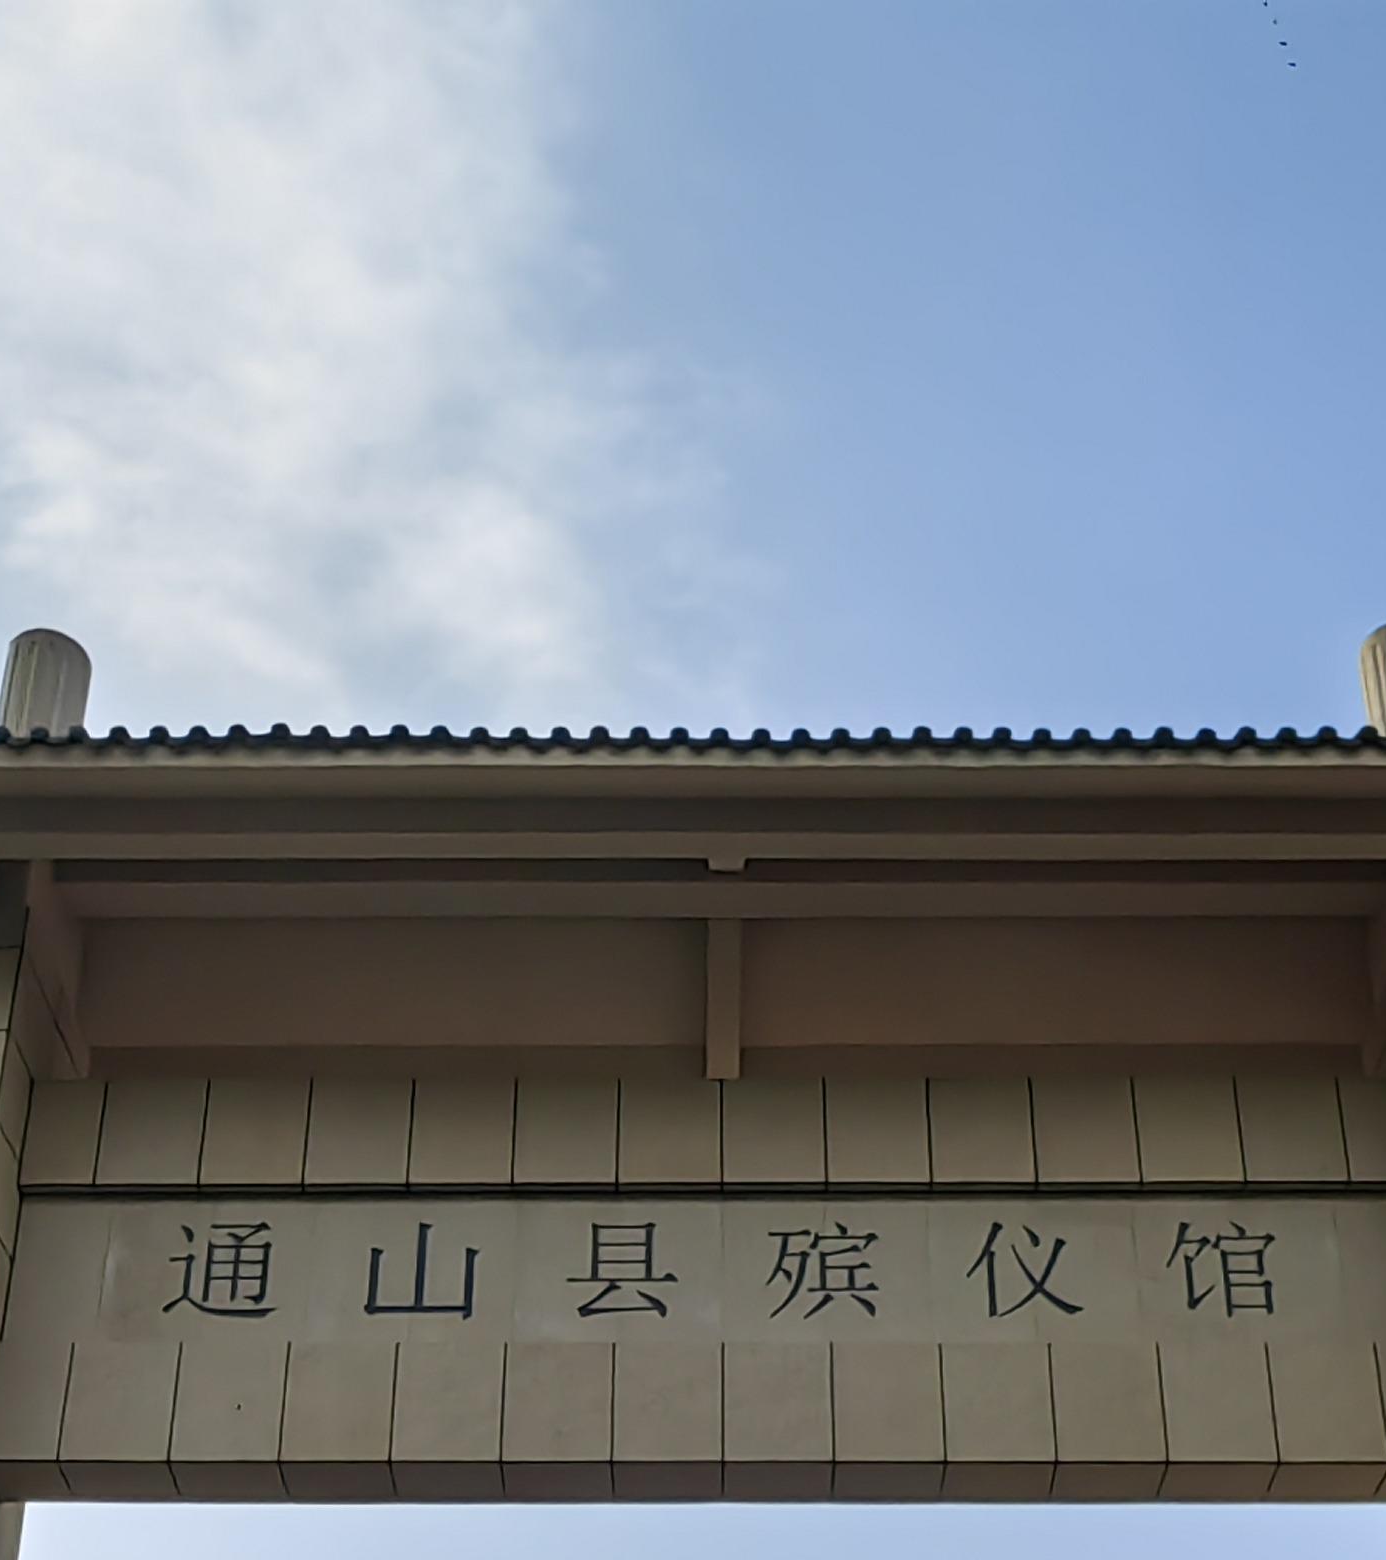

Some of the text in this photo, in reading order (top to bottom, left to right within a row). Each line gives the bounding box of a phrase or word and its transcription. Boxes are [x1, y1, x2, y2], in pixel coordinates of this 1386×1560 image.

[162, 1221, 1275, 1320] 通山县殡仪馆
